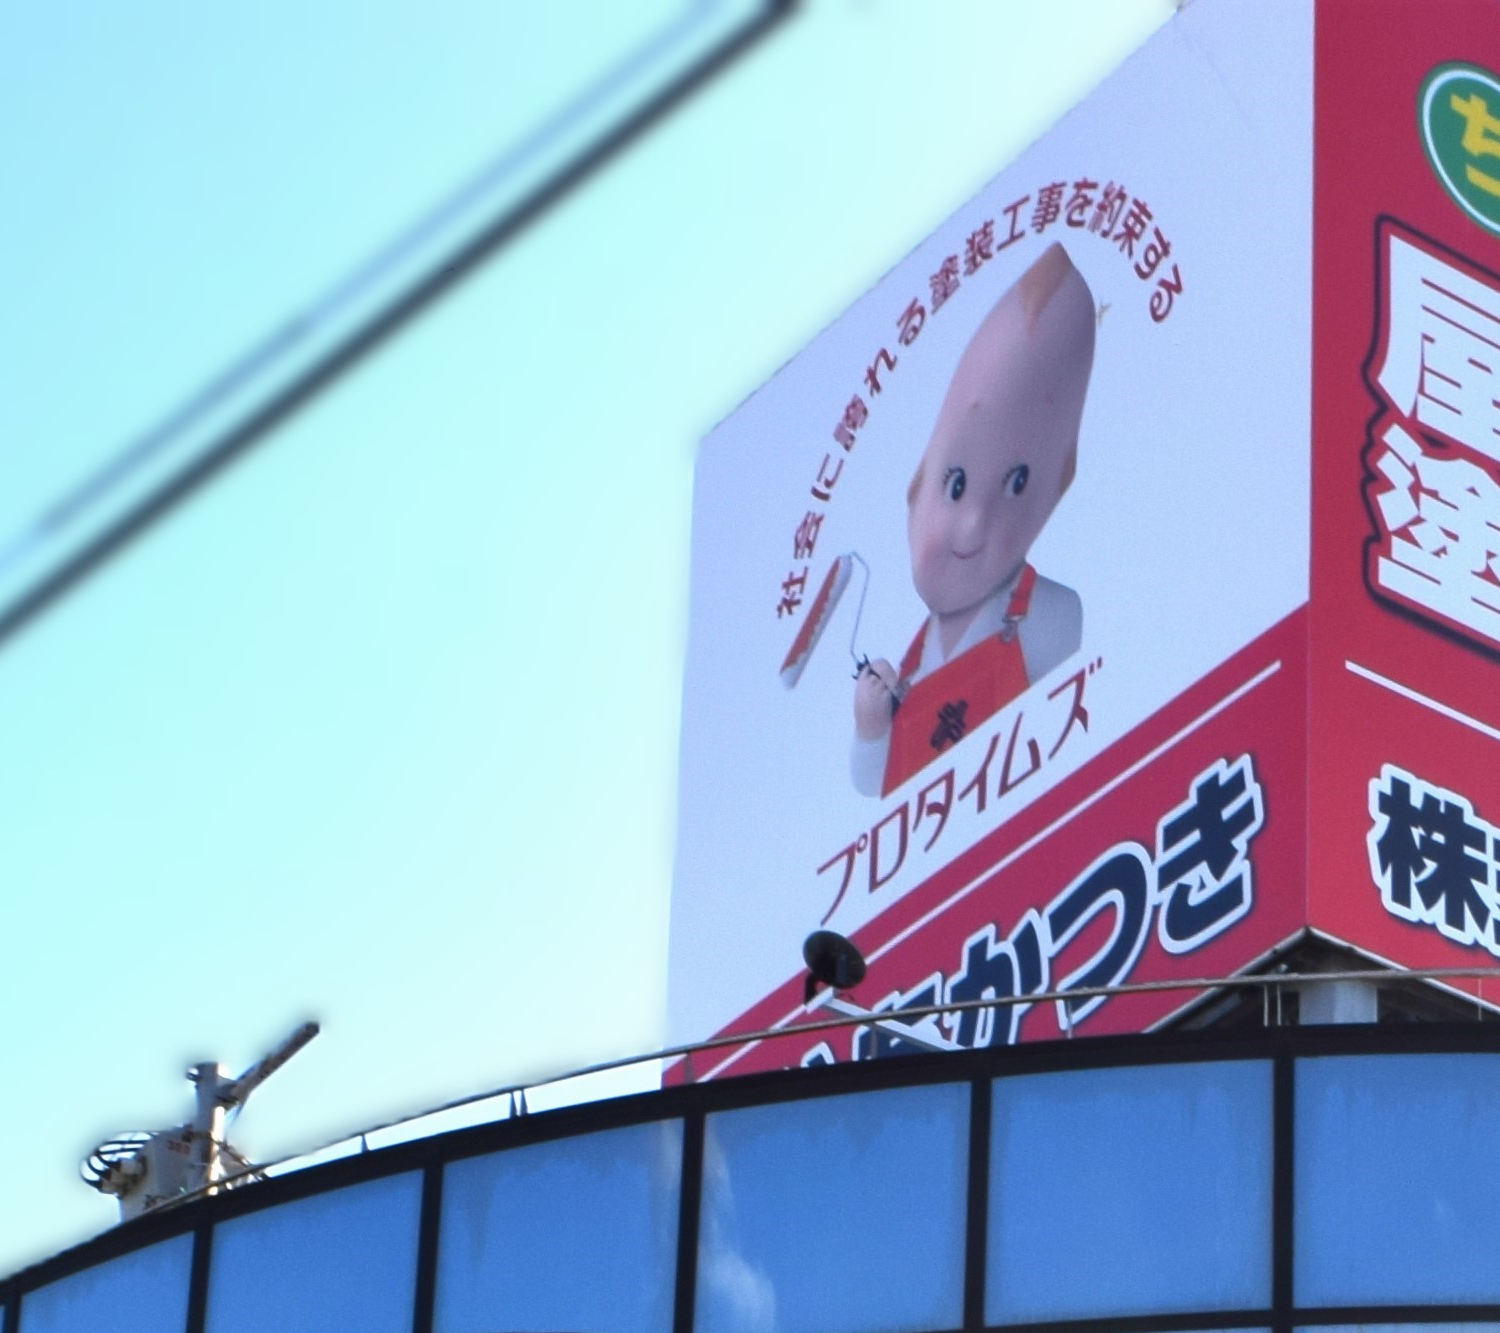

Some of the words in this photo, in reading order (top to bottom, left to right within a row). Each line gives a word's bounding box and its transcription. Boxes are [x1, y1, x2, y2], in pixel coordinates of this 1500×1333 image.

[777, 177, 1186, 620] 社会に誇れる塗装工事を約束する
[816, 658, 1104, 926] プロタイムズ
